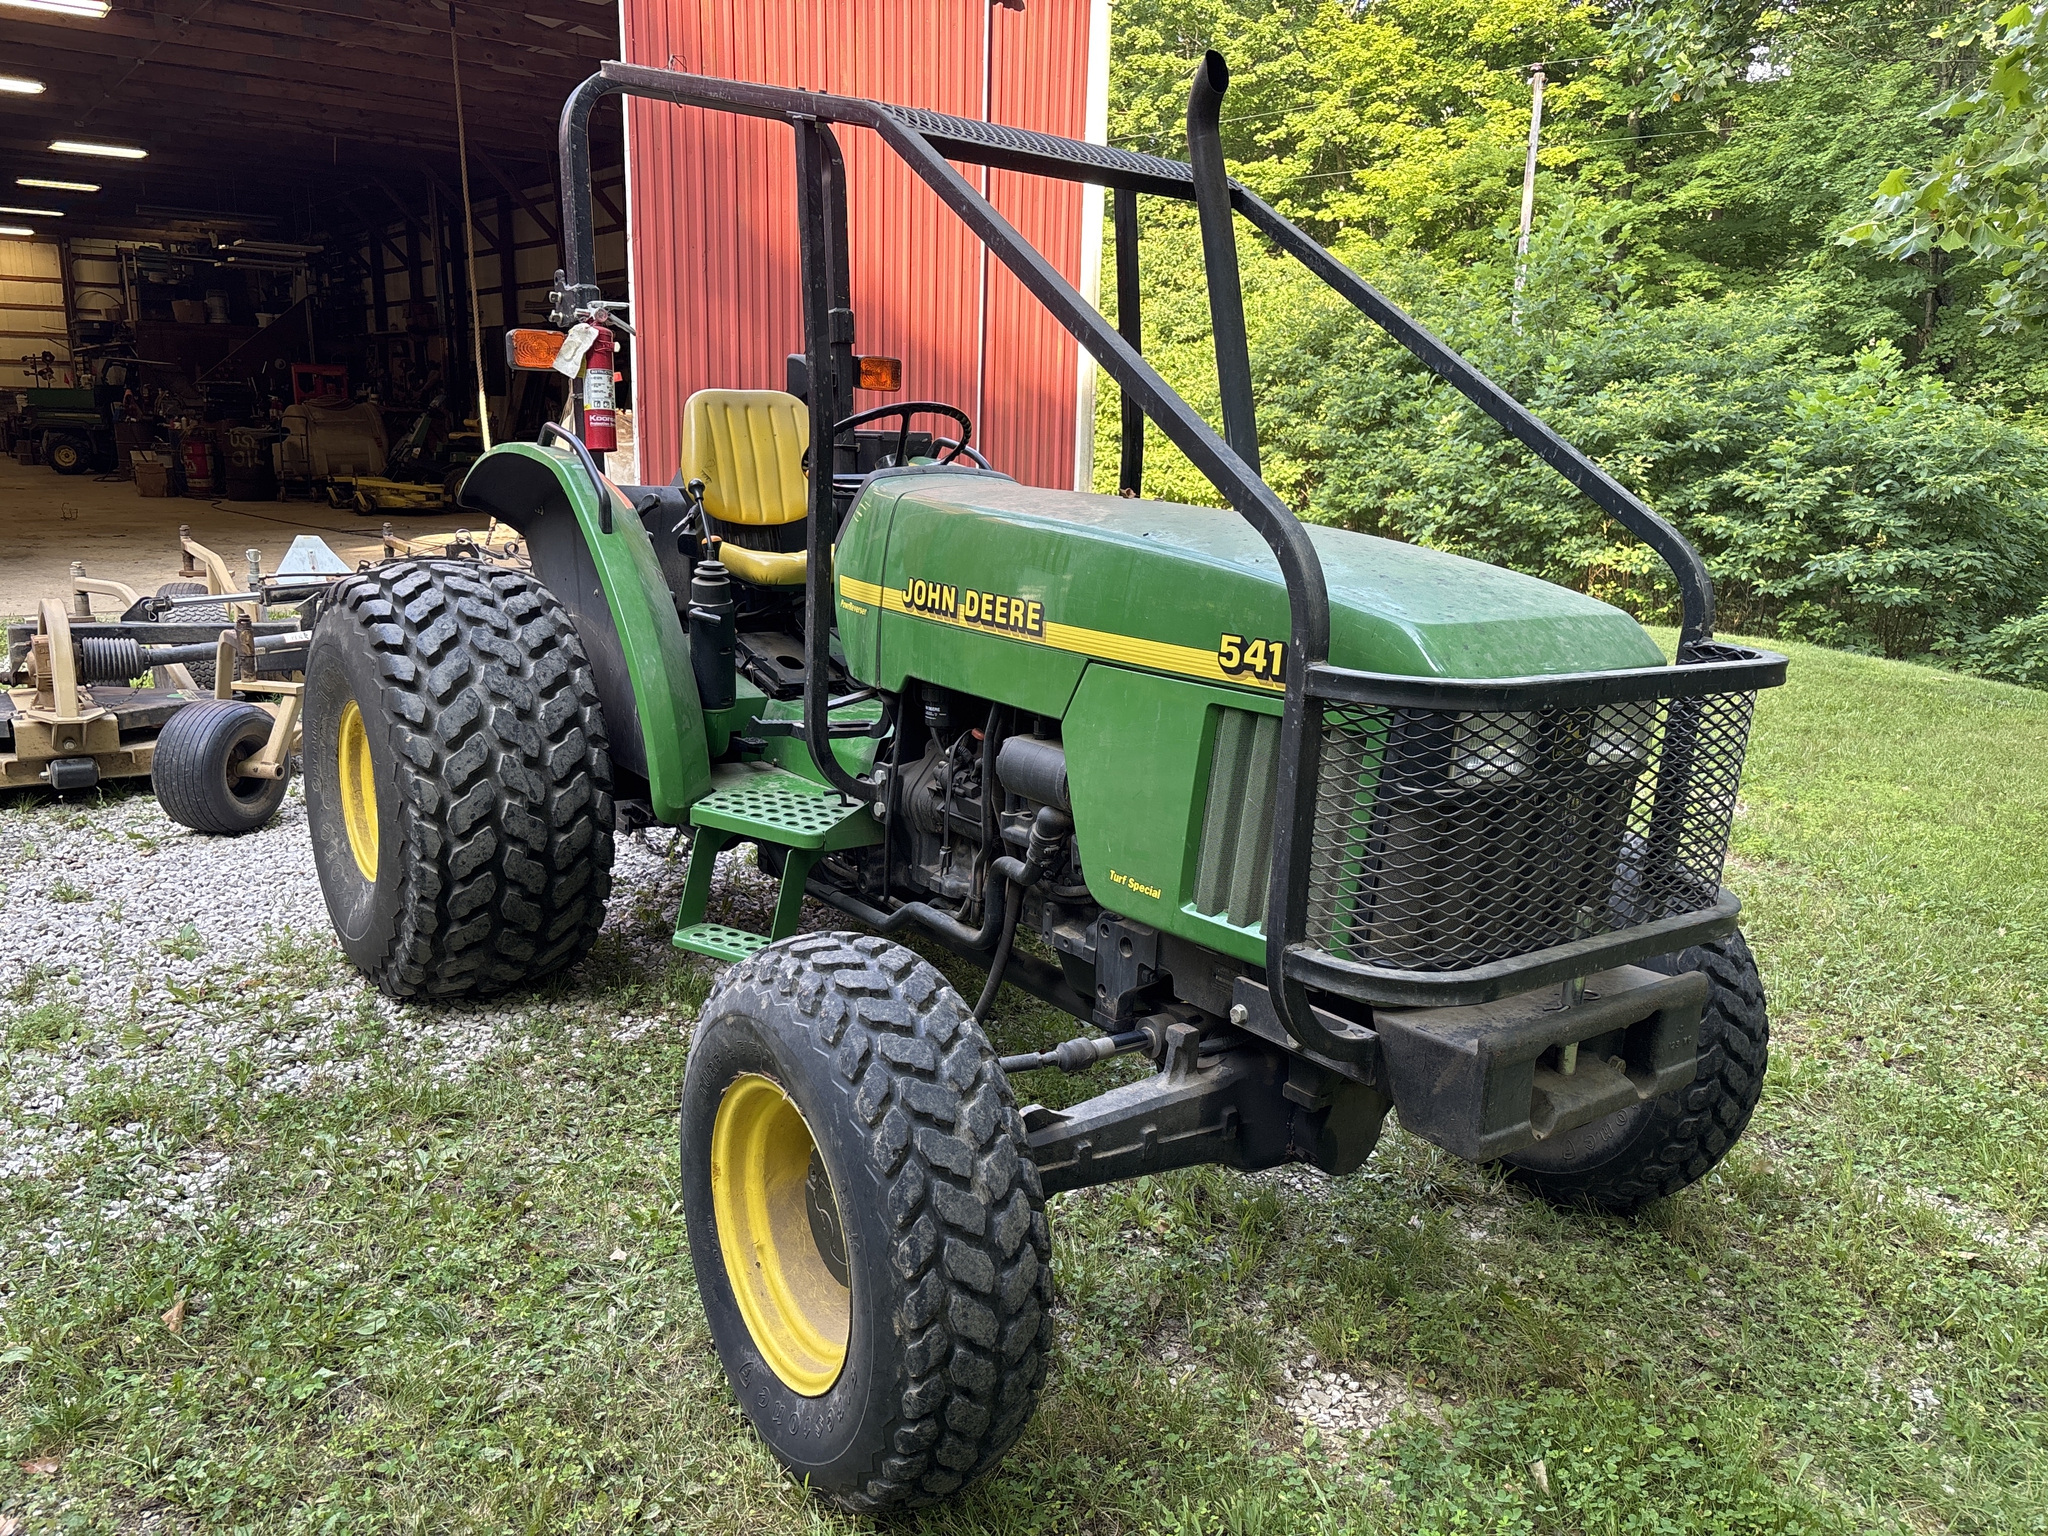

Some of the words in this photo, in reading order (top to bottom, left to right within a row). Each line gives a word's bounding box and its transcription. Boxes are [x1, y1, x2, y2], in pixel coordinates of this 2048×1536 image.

[902, 577, 959, 620] JOHN
[963, 588, 1045, 638] DEERE
[1110, 869, 1127, 885] Turf
[1127, 877, 1162, 899] Special
